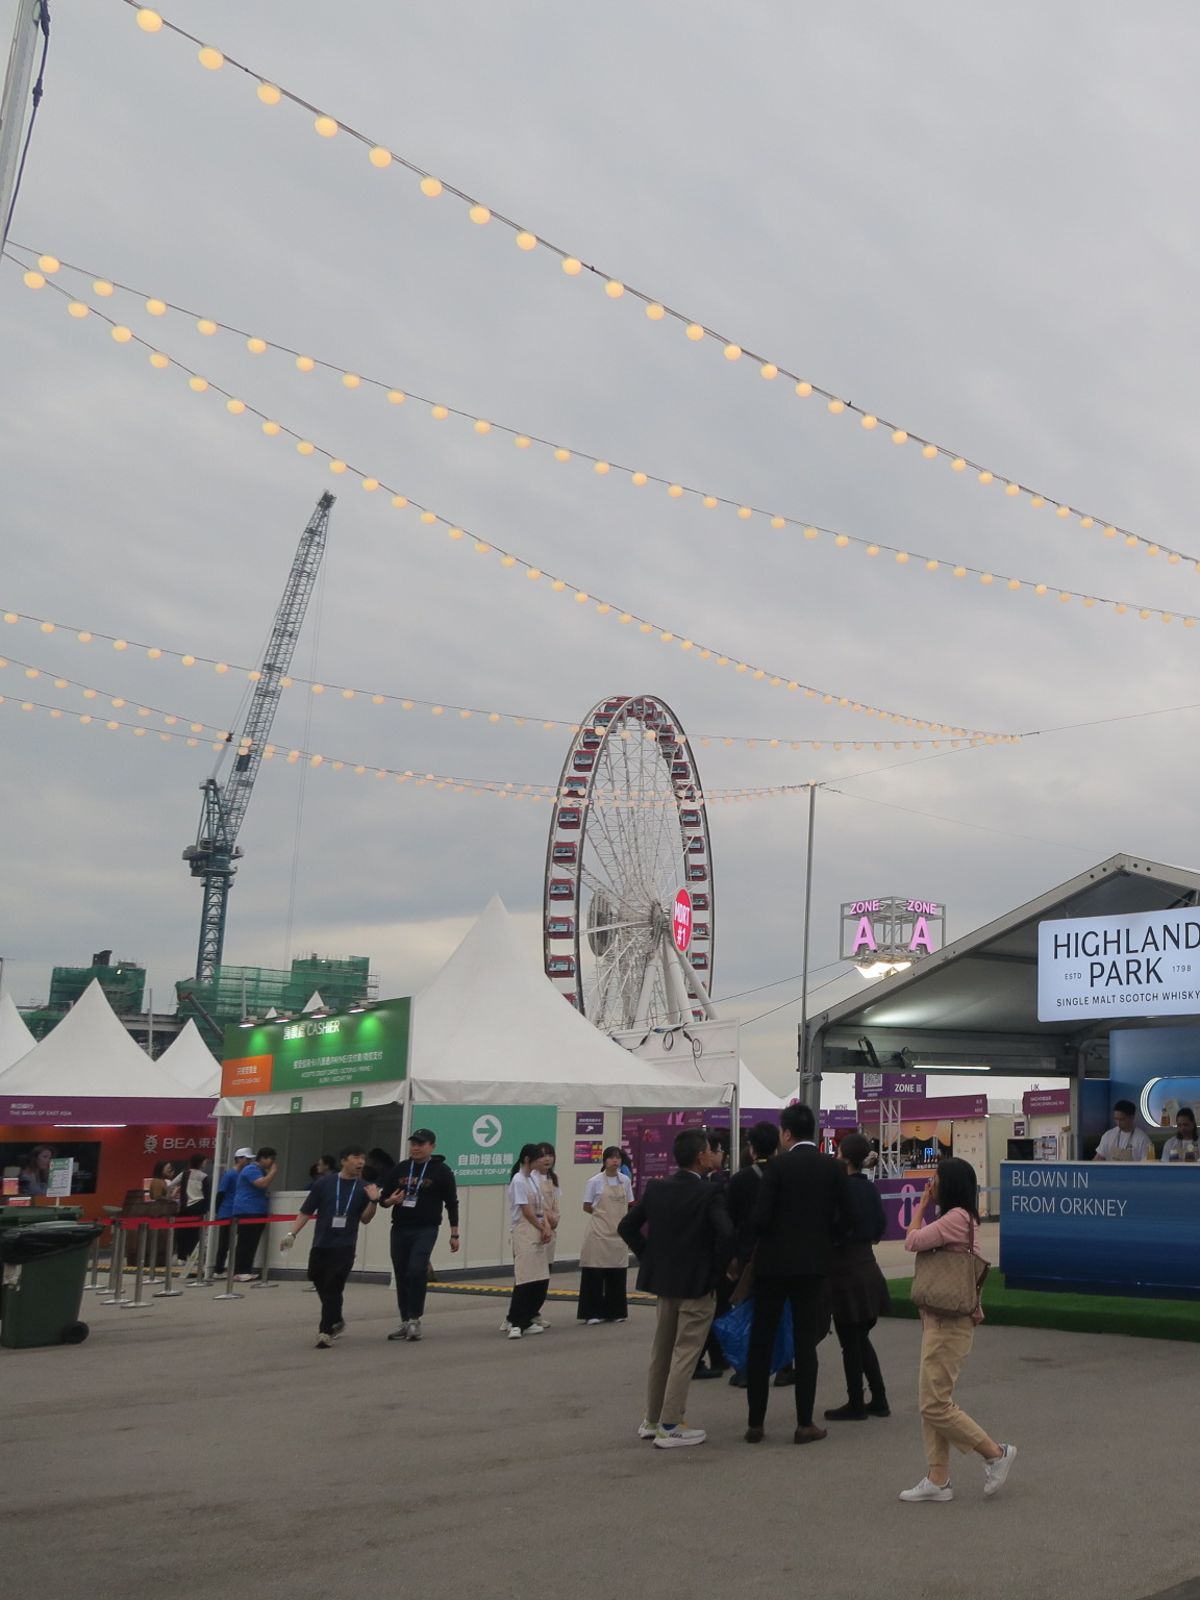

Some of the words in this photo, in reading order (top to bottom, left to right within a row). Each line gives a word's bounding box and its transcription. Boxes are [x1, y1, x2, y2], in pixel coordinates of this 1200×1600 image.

[850, 900, 880, 915] ZONE
[907, 900, 938, 915] ZONE
[852, 916, 877, 955] A
[908, 916, 935, 954] A
[1064, 972, 1082, 980] ESTD
[1090, 957, 1163, 988] PARK
[1172, 965, 1192, 973] 1798
[1056, 996, 1089, 1007] SINGLE
[1092, 994, 1116, 1005] MALT
[1119, 992, 1158, 1003] SCOTCH
[1162, 990, 1200, 1001] WHISKY
[307, 1020, 340, 1036] CASHIER
[894, 1083, 914, 1093] ZONE
[163, 1137, 196, 1149] BEA
[458, 1153, 514, 1166] 自助增值機
[485, 1168, 506, 1176] TOP-UP
[1012, 1170, 1067, 1188] BLOWN
[1073, 1171, 1089, 1189] IN
[1011, 1195, 1055, 1213] FROM
[1060, 1197, 1127, 1217] ORKNEY
